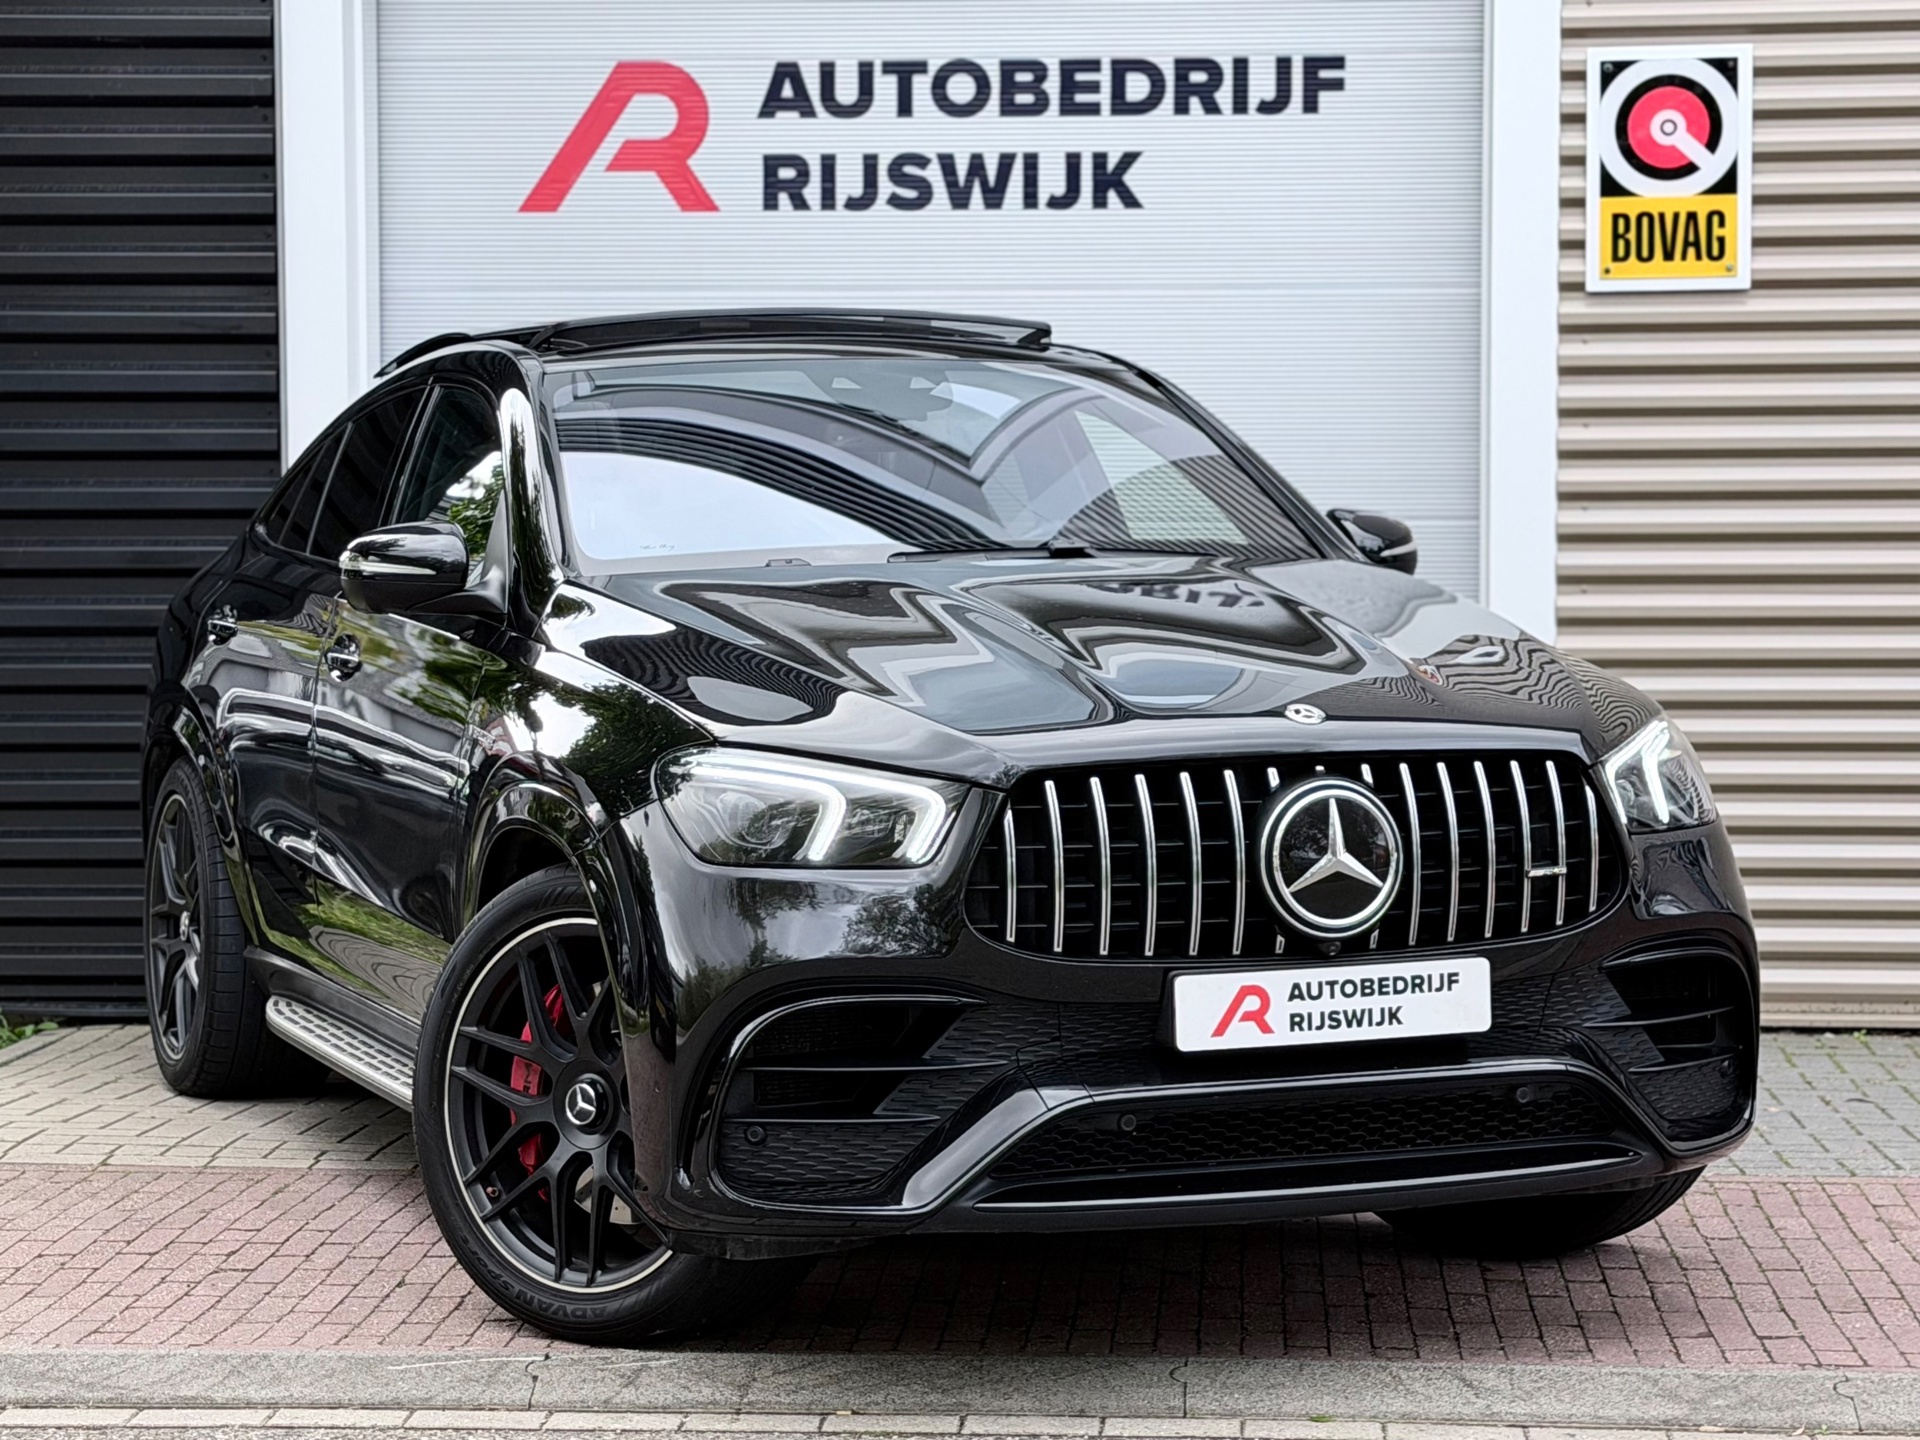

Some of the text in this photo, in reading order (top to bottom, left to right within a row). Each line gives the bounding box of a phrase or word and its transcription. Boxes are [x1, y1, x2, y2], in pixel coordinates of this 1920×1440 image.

[758, 56, 1346, 119] AUTOBEDRIJF
[763, 152, 1143, 211] RIJSWIJK
[1611, 210, 1726, 263] BOVAG
[1287, 972, 1460, 1002] AUTOBEDRIJF
[1289, 1006, 1404, 1032] RIJSWIJK
[514, 1288, 608, 1320] ADVAN
